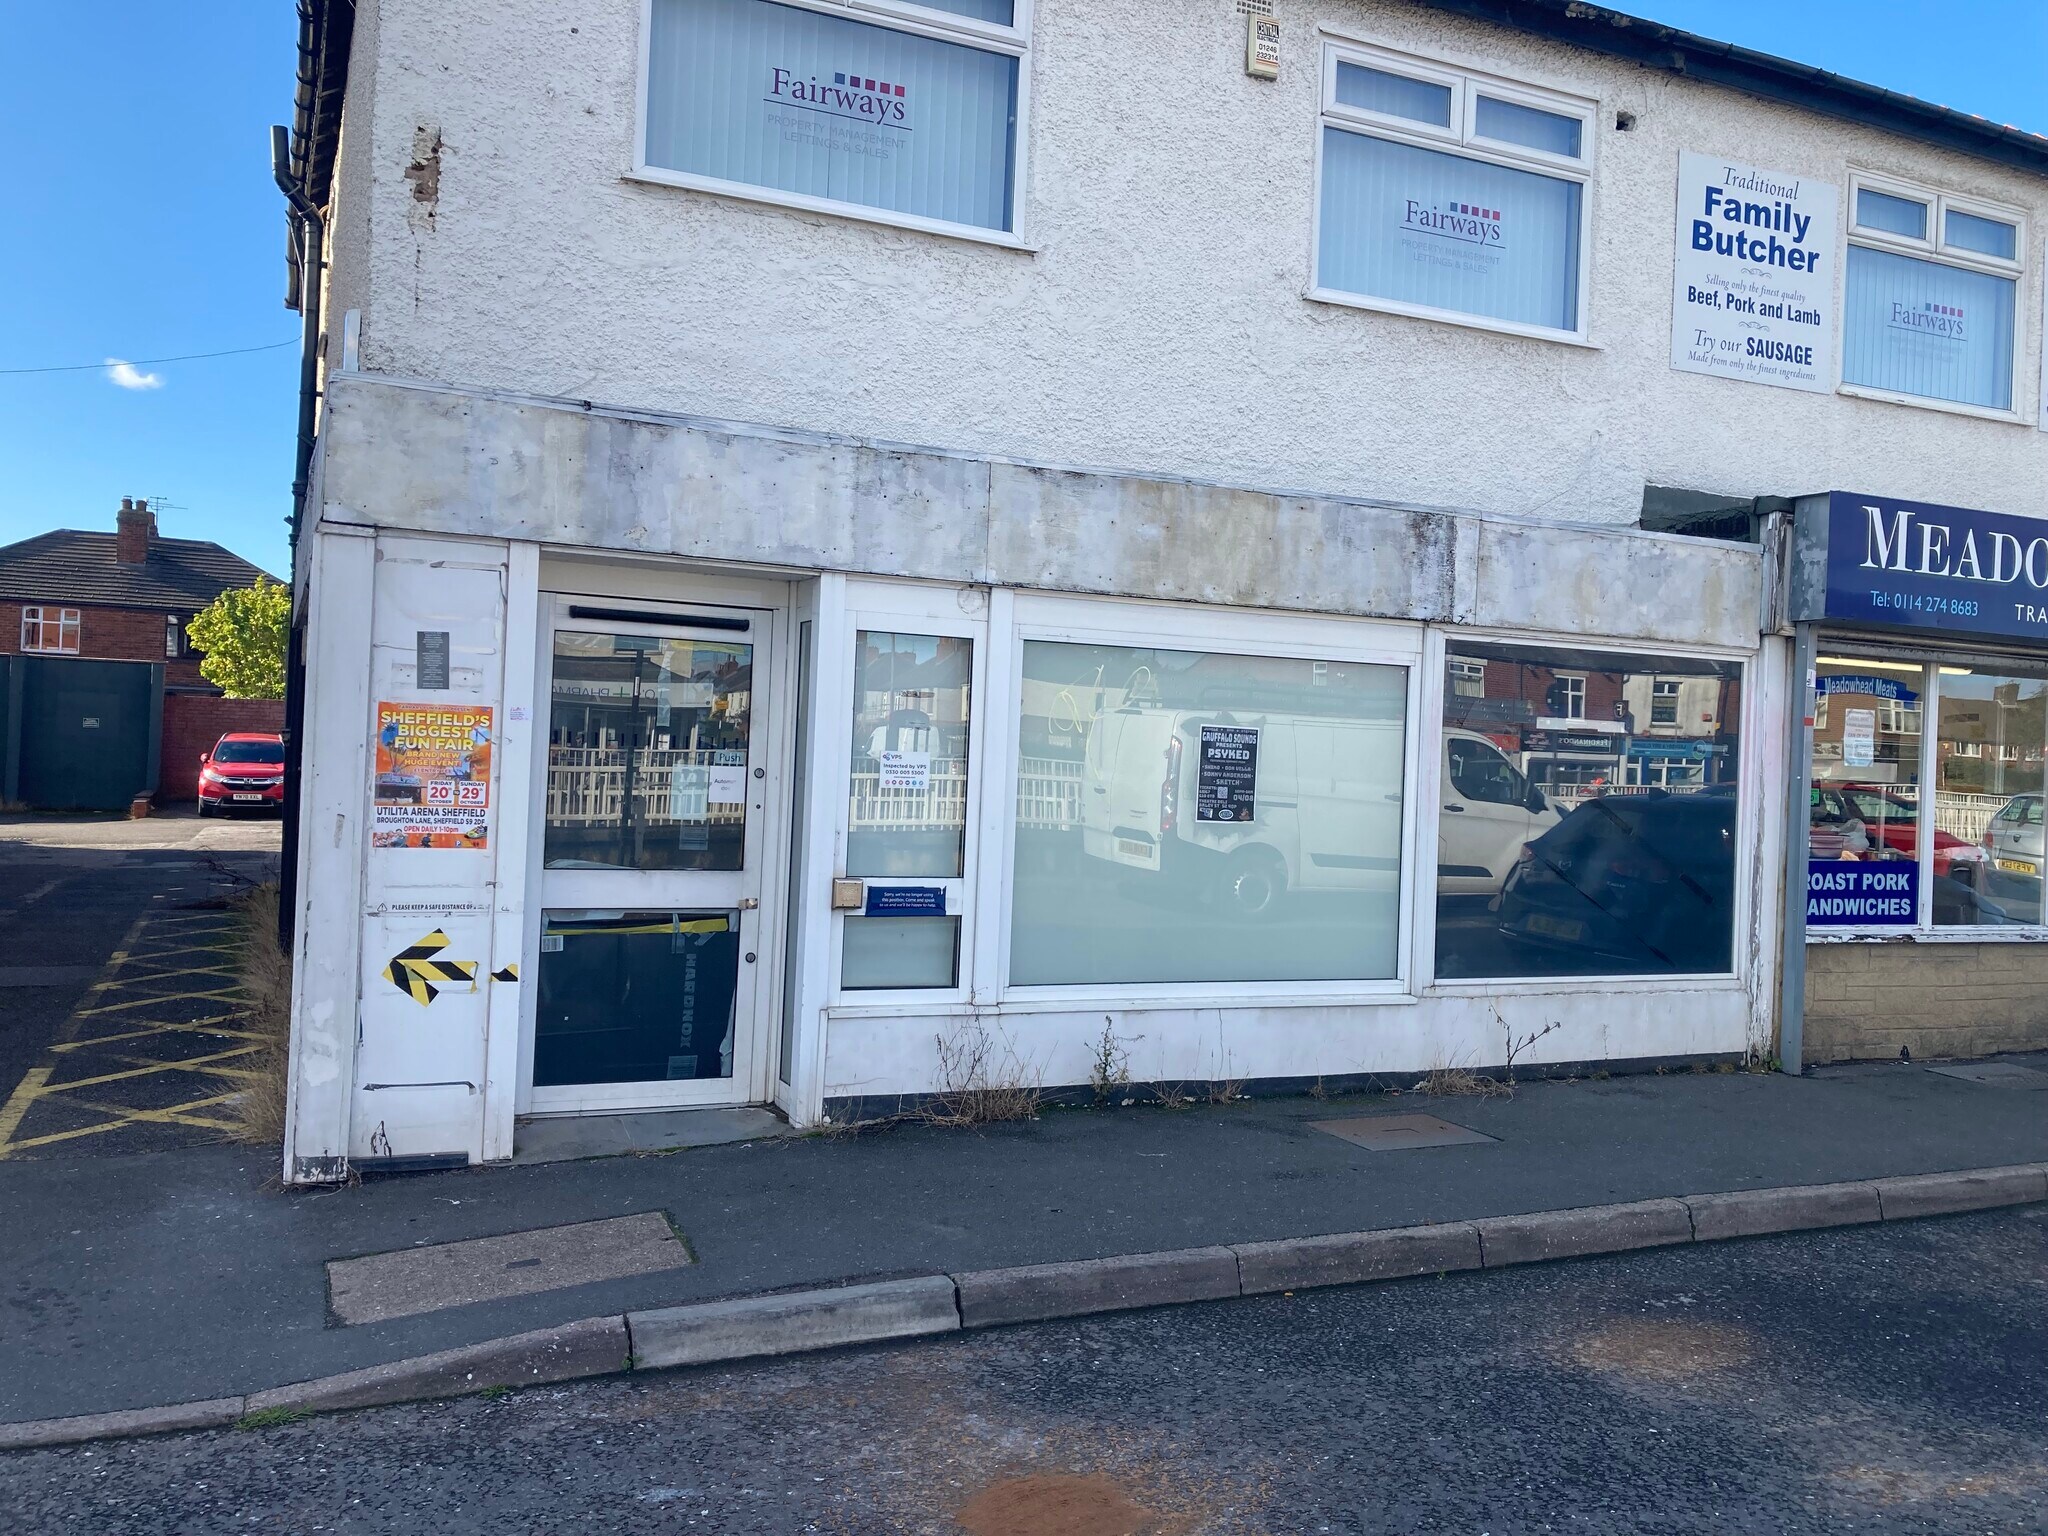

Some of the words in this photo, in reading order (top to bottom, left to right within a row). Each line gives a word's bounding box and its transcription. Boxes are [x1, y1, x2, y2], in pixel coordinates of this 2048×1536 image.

[771, 67, 905, 125] Fairways
[768, 114, 825, 133] PROPERTY
[830, 127, 906, 149] MANAGEMENT
[784, 132, 839, 149] LETTINGS
[843, 143, 851, 151] &
[855, 144, 889, 159] SALES
[1723, 166, 1799, 200] Traditional
[1405, 200, 1500, 245] Fairways
[1705, 185, 1811, 243] Family
[1692, 219, 1820, 273] Butcher
[1705, 274, 1730, 291] Selling
[1732, 280, 1746, 293] only
[1750, 282, 1759, 293] the
[1759, 285, 1779, 298] finest
[1781, 290, 1806, 304] quality
[1688, 285, 1721, 311] Beef,
[1727, 293, 1755, 314] Pork
[1760, 302, 1783, 319] and
[1788, 305, 1820, 326] Lamb
[1891, 302, 1963, 339] Fairways
[1694, 329, 1716, 353] Try
[1720, 340, 1742, 351] our
[1746, 337, 1812, 366] SAUSAGE
[1688, 350, 1708, 363] Made
[1710, 355, 1728, 368] from
[1730, 358, 1745, 373] only
[1746, 359, 1757, 372] the
[1757, 364, 1777, 376] finest
[1780, 368, 1816, 381] ingredients
[1870, 591, 1890, 608] Tel:
[1894, 593, 1922, 611] 0114
[1926, 596, 1948, 613] 274
[1950, 600, 1978, 616] 8683
[1825, 678, 1874, 695] Meadowhead
[1876, 678, 1897, 698] Meats
[381, 711, 490, 727] SHEFFIELD'S
[398, 724, 472, 738] BIGGEST
[394, 737, 430, 750] FUN
[435, 738, 474, 750] FAIR
[1202, 732, 1232, 742] GRUFFALO
[1234, 734, 1256, 744] SOUNDS
[719, 751, 741, 762] Push
[1208, 748, 1250, 760] PSYKED
[377, 807, 409, 816] UTILITA
[410, 808, 440, 816] ARENA
[442, 808, 486, 818] SHEFFIELD
[377, 816, 414, 824] BROUGHTON
[415, 817, 432, 825] LANE,
[1862, 873, 1910, 890] PORK
